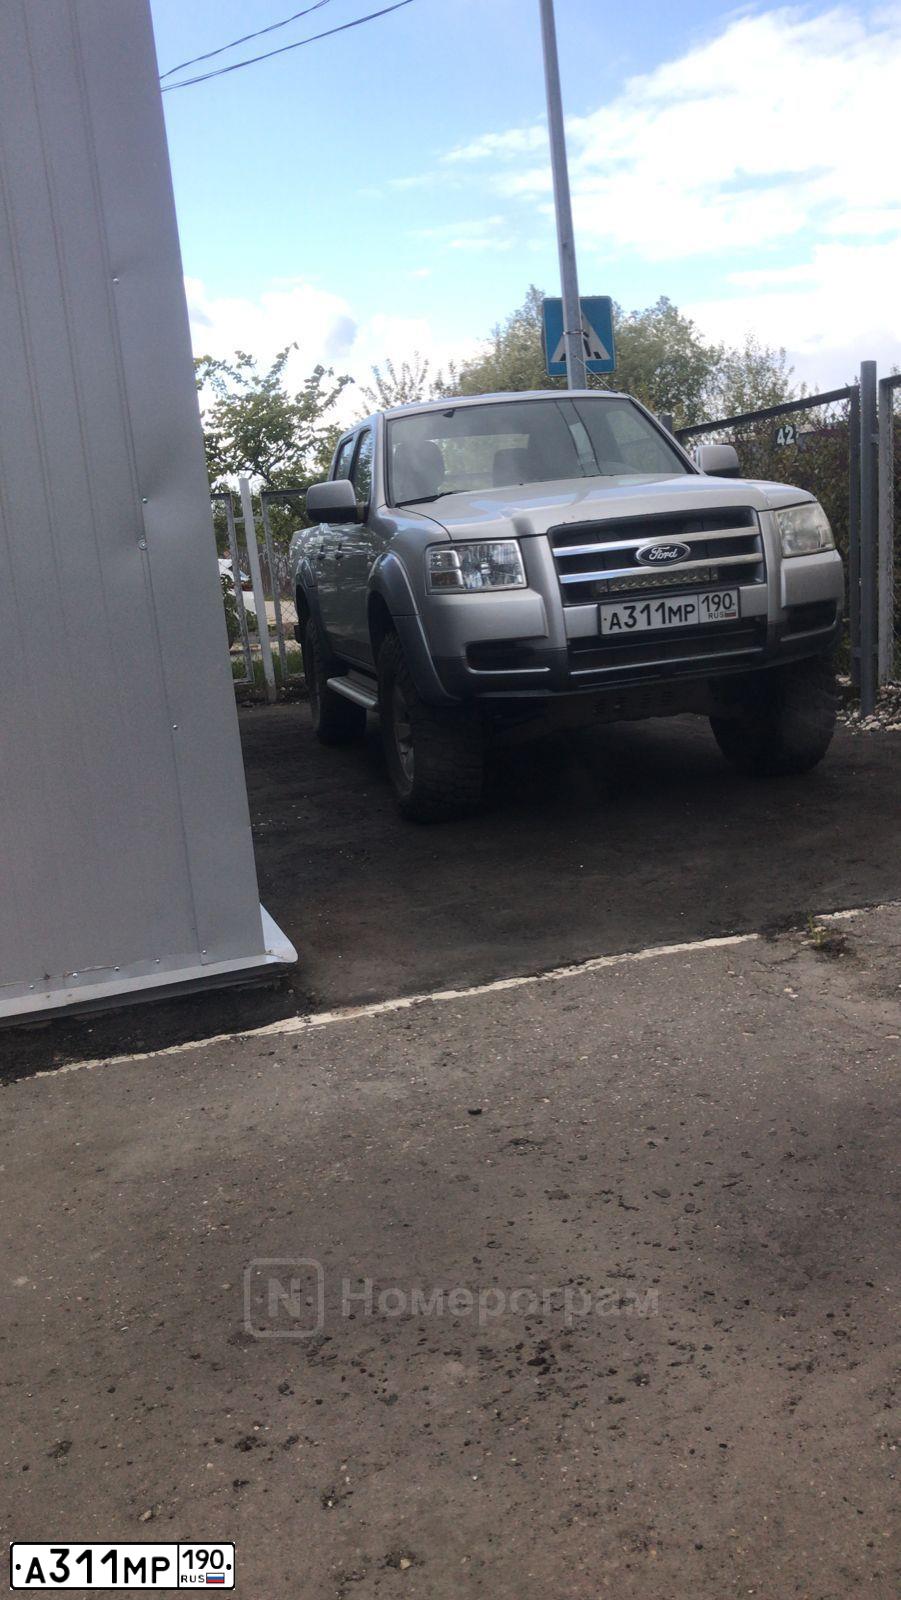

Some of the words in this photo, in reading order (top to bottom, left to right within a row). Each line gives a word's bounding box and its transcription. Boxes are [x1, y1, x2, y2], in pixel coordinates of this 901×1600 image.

[777, 425, 795, 446] 42
[648, 546, 678, 560] Ford
[609, 602, 696, 631] А311МР
[701, 593, 733, 612] 190
[708, 612, 724, 620] RUS
